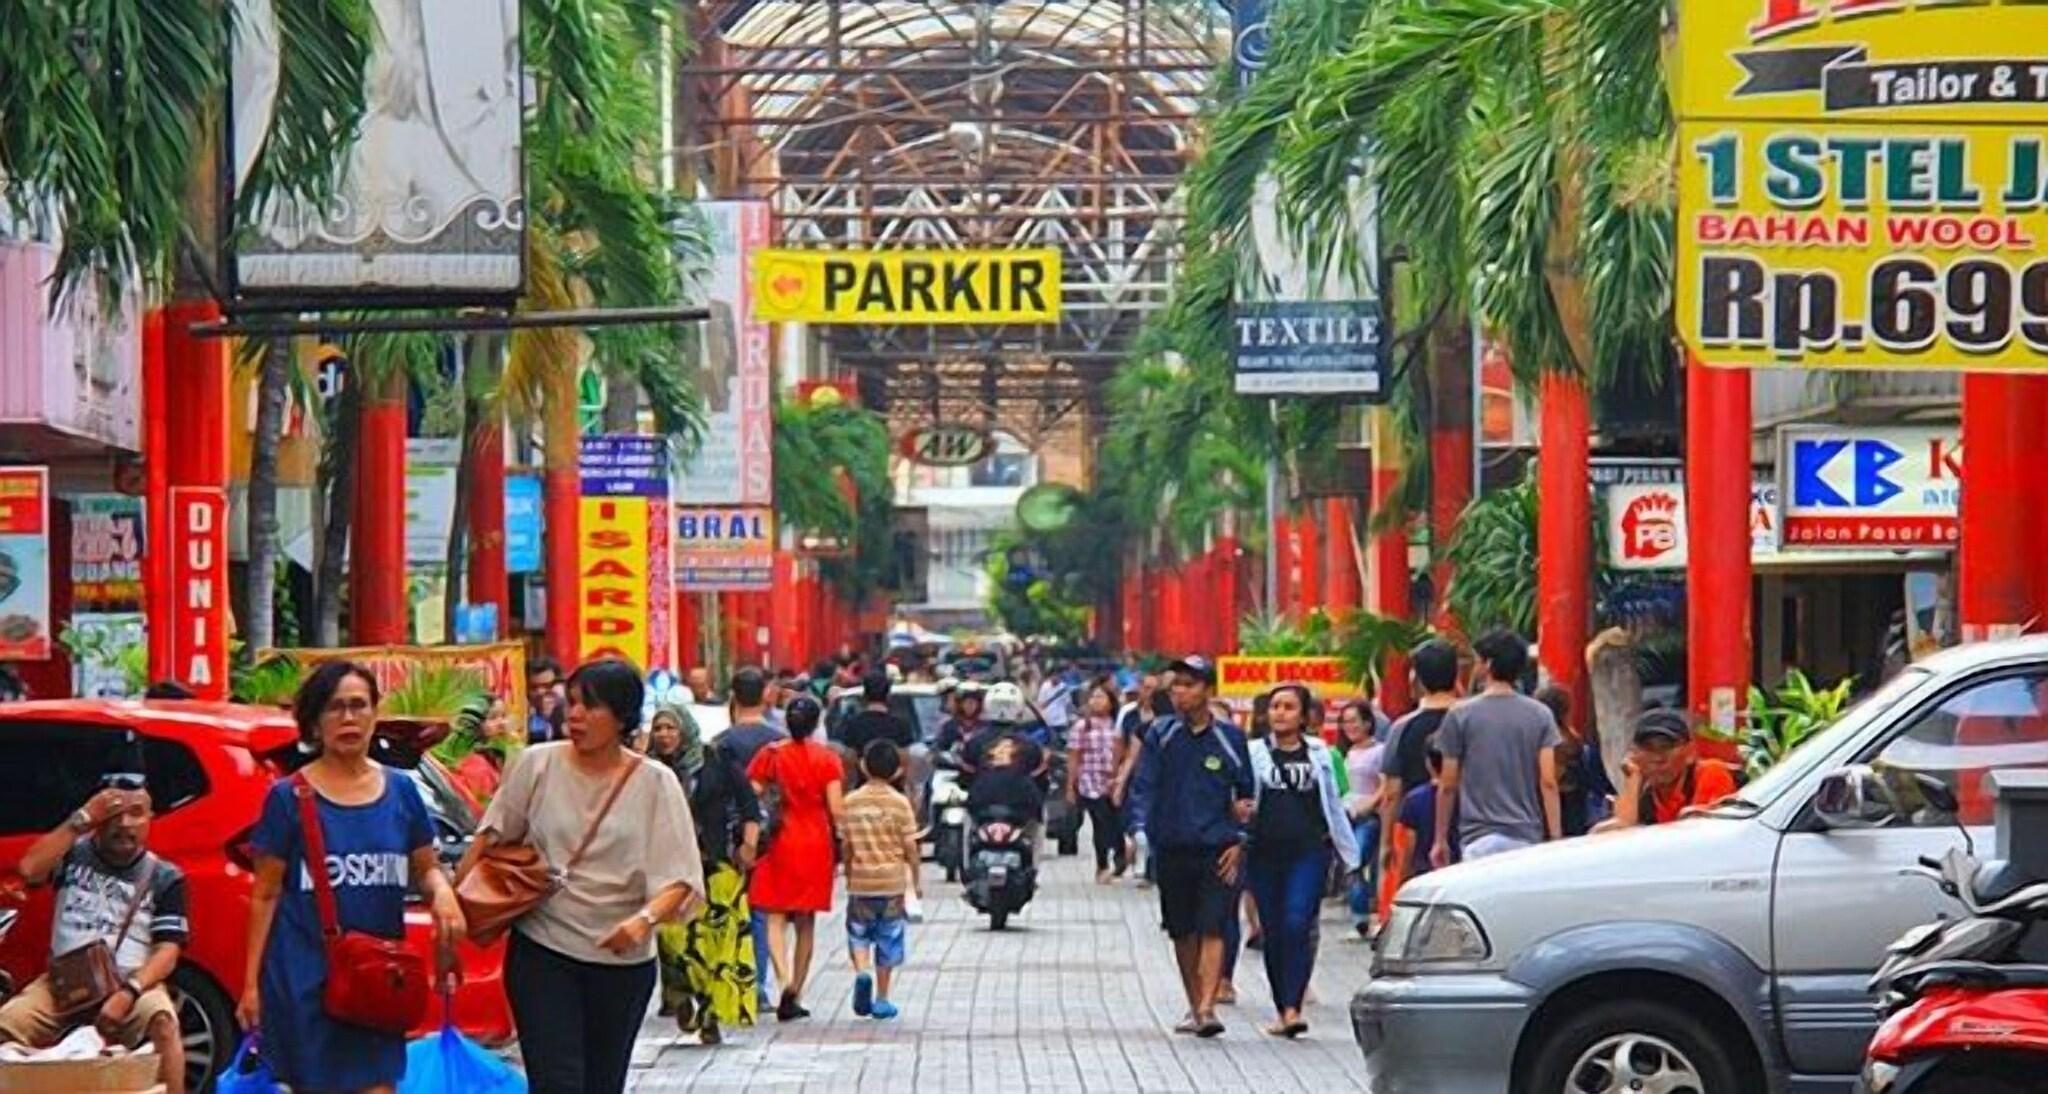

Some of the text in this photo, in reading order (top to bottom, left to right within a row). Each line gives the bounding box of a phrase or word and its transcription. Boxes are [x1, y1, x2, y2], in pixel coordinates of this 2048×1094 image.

[1871, 68, 1977, 105] Tailor
[1988, 65, 2017, 98] &
[1695, 135, 2048, 206] 1 STEL J
[1698, 214, 2033, 246] BAHAN WOOL
[823, 261, 1048, 312] PARKIR
[1235, 315, 1380, 346] TEXTILE
[1795, 440, 1904, 506] KB
[1790, 524, 1852, 541] Jalan
[1859, 523, 1923, 541] Pasar
[188, 502, 212, 686] DUNIA
